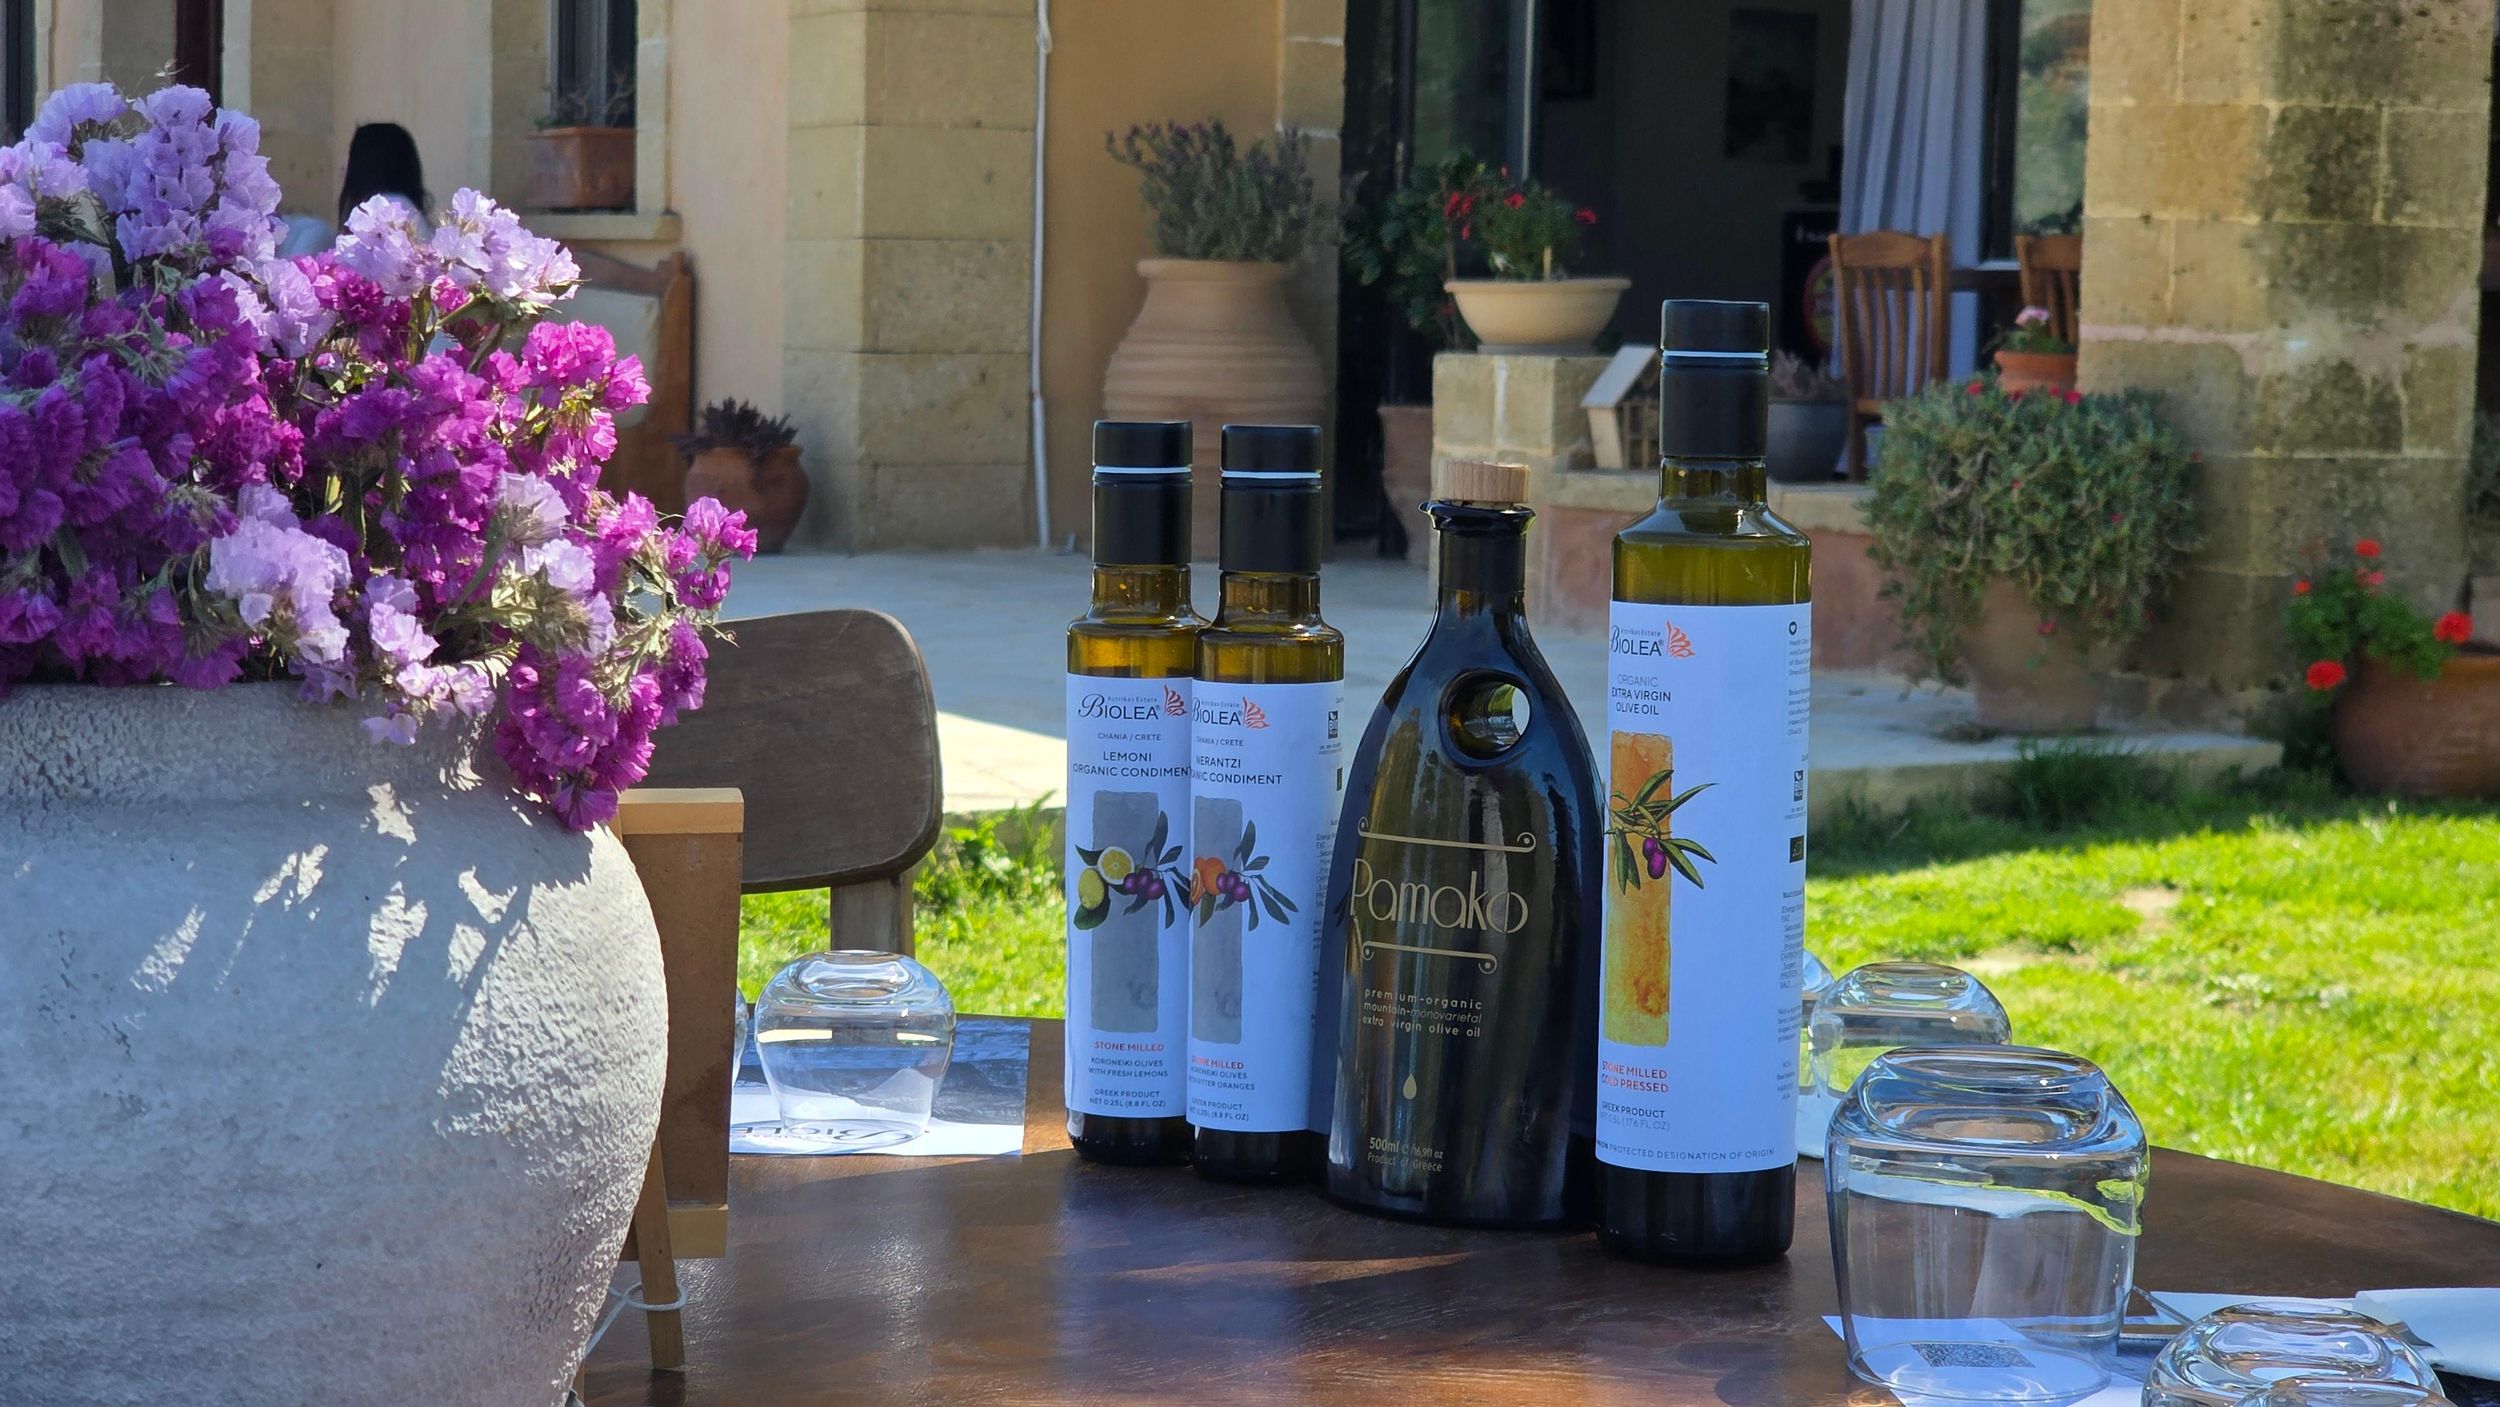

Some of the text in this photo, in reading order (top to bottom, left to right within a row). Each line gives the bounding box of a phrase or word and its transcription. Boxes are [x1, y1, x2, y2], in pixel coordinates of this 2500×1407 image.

[1610, 625, 1662, 656] BIOLEA
[1617, 674, 1658, 688] ORGANIC
[1612, 687, 1671, 702] EXTRA VIRGIN
[1078, 693, 1159, 720] BIOLEA
[1192, 696, 1242, 726] BIOLEA
[1616, 702, 1660, 715] OLIVE OIL
[1098, 732, 1128, 740] CHANIA
[1220, 738, 1244, 746] CRETE
[1103, 752, 1152, 762] LEMONI
[1196, 754, 1241, 768] NERANTZI
[1072, 763, 1118, 776] ORGANIC
[1210, 772, 1282, 784] CONDIMENT
[1350, 858, 1528, 934] Pamako
[1364, 988, 1482, 1010] premum-organic
[1364, 1002, 1482, 1024] mountain-monovarietal
[1362, 1016, 1480, 1038] extra virgin olive oil
[1094, 1041, 1165, 1052] STONE MILLED
[1090, 1056, 1164, 1067] KORONEIKI OLIVES
[1211, 1059, 1244, 1070] MILLED
[1088, 1067, 1168, 1078] WITH FRESH LEMONS
[1220, 1070, 1248, 1080] OLIVES
[1602, 1060, 1668, 1080] STONE MILLED
[1217, 1082, 1256, 1091] ORANGES
[1601, 1073, 1669, 1093] COLD PRESSED
[1094, 1088, 1161, 1098] GREEK PRODUCT
[1089, 1097, 1102, 1105] NET
[1208, 1101, 1243, 1111] PRODUCT
[1601, 1100, 1666, 1118] GREEK PRODUCT
[1234, 1112, 1250, 1122] OZ)
[1369, 1136, 1400, 1152] 500ml
[1434, 1150, 1444, 1160] oz
[1610, 1144, 1654, 1158] PROTECTED
[1656, 1150, 1726, 1160] DESIGNATION
[1730, 1150, 1742, 1160] OF
[1745, 1147, 1775, 1158] ORIGIN
[1367, 1152, 1396, 1166] Product
[1413, 1159, 1442, 1172] Greece
